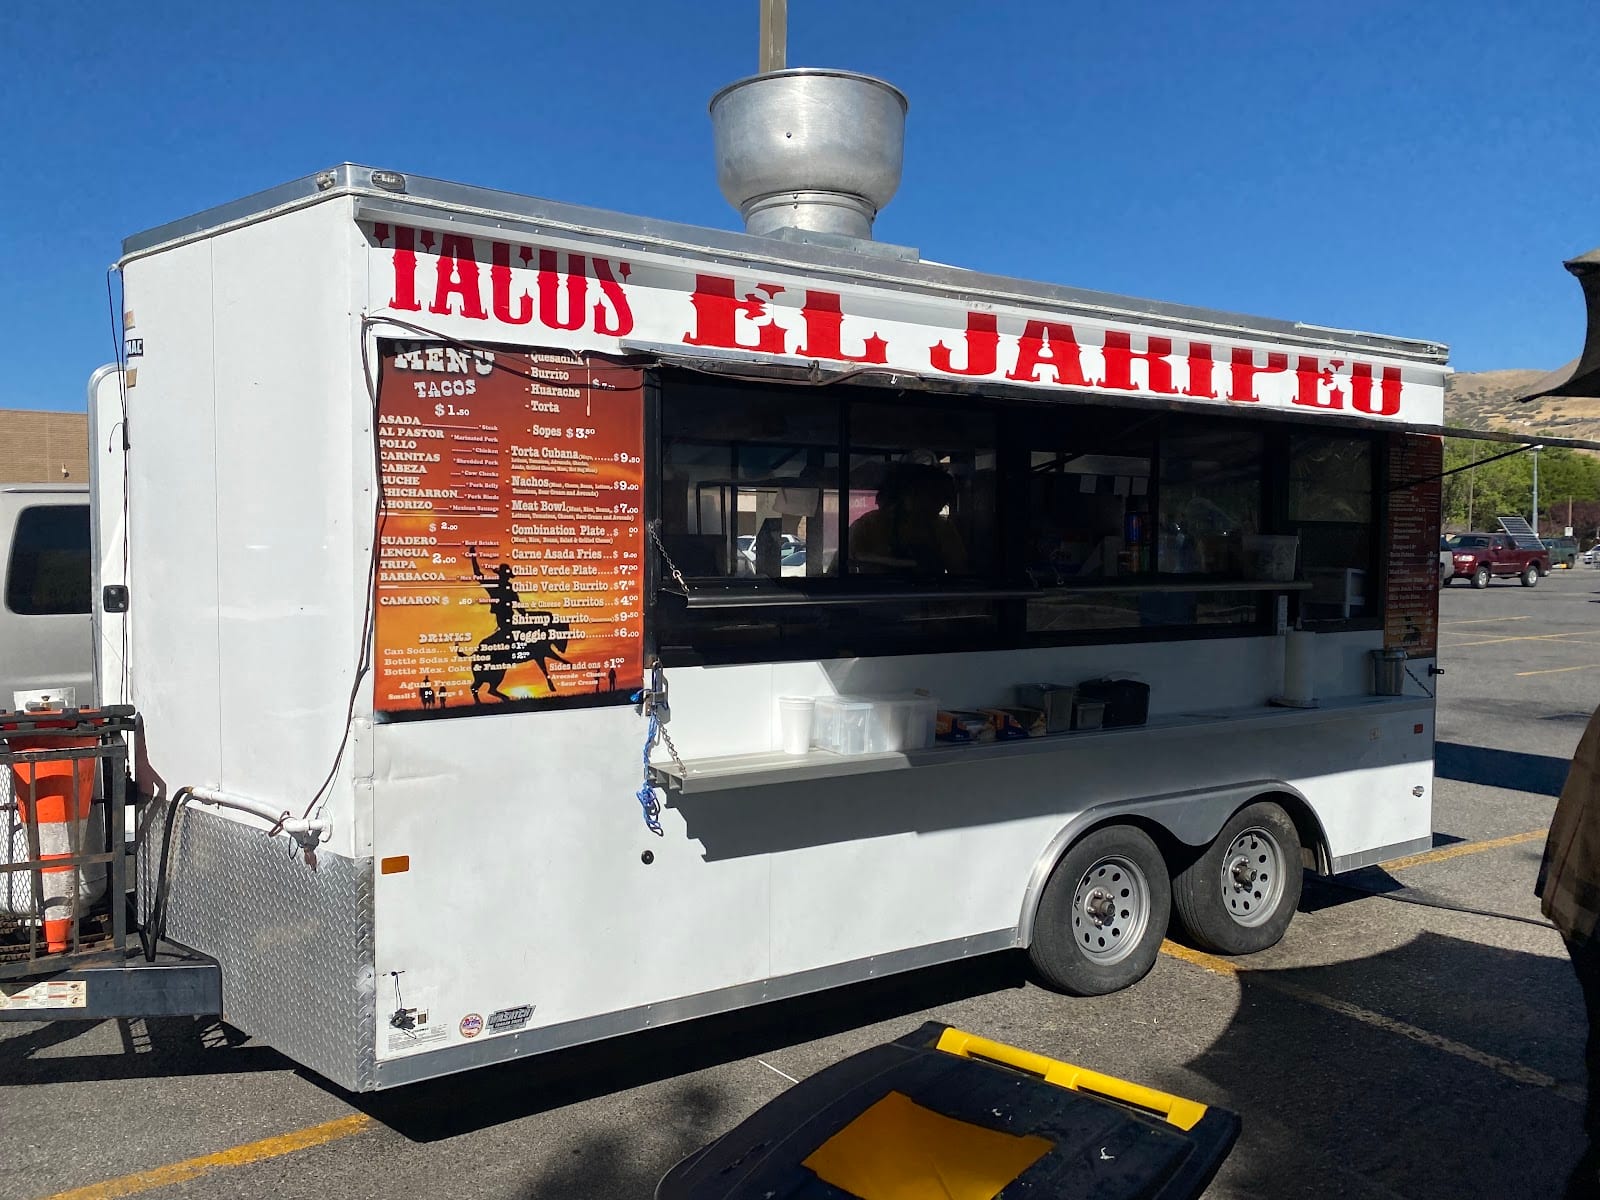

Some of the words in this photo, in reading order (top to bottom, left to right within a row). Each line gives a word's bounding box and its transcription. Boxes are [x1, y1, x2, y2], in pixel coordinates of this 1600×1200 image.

[683, 272, 888, 363] EL
[394, 343, 495, 375] MENU
[531, 352, 584, 365] Quesada
[531, 367, 569, 380] Burrito
[414, 379, 476, 398] TACOS
[531, 384, 580, 398] Huarache
[531, 400, 560, 413] Torta
[379, 415, 422, 426] ASADA
[379, 428, 396, 436] AL
[398, 429, 444, 438] PASTOR
[533, 425, 562, 438] Sopes
[380, 440, 416, 449] POLLO
[381, 452, 440, 462] CARNITAS
[511, 446, 540, 458] Torta
[542, 447, 579, 459] Cubana
[382, 464, 428, 474] CABEZA
[512, 476, 549, 488] Nachos
[512, 500, 538, 511] Meat
[541, 501, 566, 511] Bowl
[512, 524, 576, 536] Combination
[580, 526, 605, 536] Plate
[381, 537, 437, 546] SUADERO
[381, 549, 430, 558] LENGUA
[432, 553, 456, 564] 2.00
[512, 549, 542, 559] Carne
[544, 549, 574, 559] Asada
[577, 549, 602, 559] Fries
[381, 561, 417, 569] TRIPA
[512, 565, 538, 575] Chile
[541, 565, 570, 575] Verde
[572, 565, 598, 576] Plate
[381, 572, 446, 581] BARBACOA
[512, 581, 538, 592] Chile
[541, 581, 571, 592] Verde
[574, 581, 608, 592] Burrito
[381, 597, 440, 606] CAMARON
[563, 597, 604, 608] Burritos
[512, 614, 550, 626] Shirmp
[552, 612, 588, 624] Burrito
[419, 633, 472, 644] DRINKS
[512, 630, 546, 642] Veggie
[548, 629, 586, 640] Burrito
[384, 648, 404, 656] Can
[384, 657, 416, 666] Bottle
[419, 656, 448, 664] Sodas
[451, 654, 491, 662] Jarritos
[384, 668, 416, 676] Bottle
[448, 665, 472, 673] Coke
[484, 662, 517, 671] Fantas
[550, 662, 570, 672] Sides
[572, 662, 586, 670] add
[400, 682, 432, 690] Aguas
[434, 679, 472, 687] Frescas
